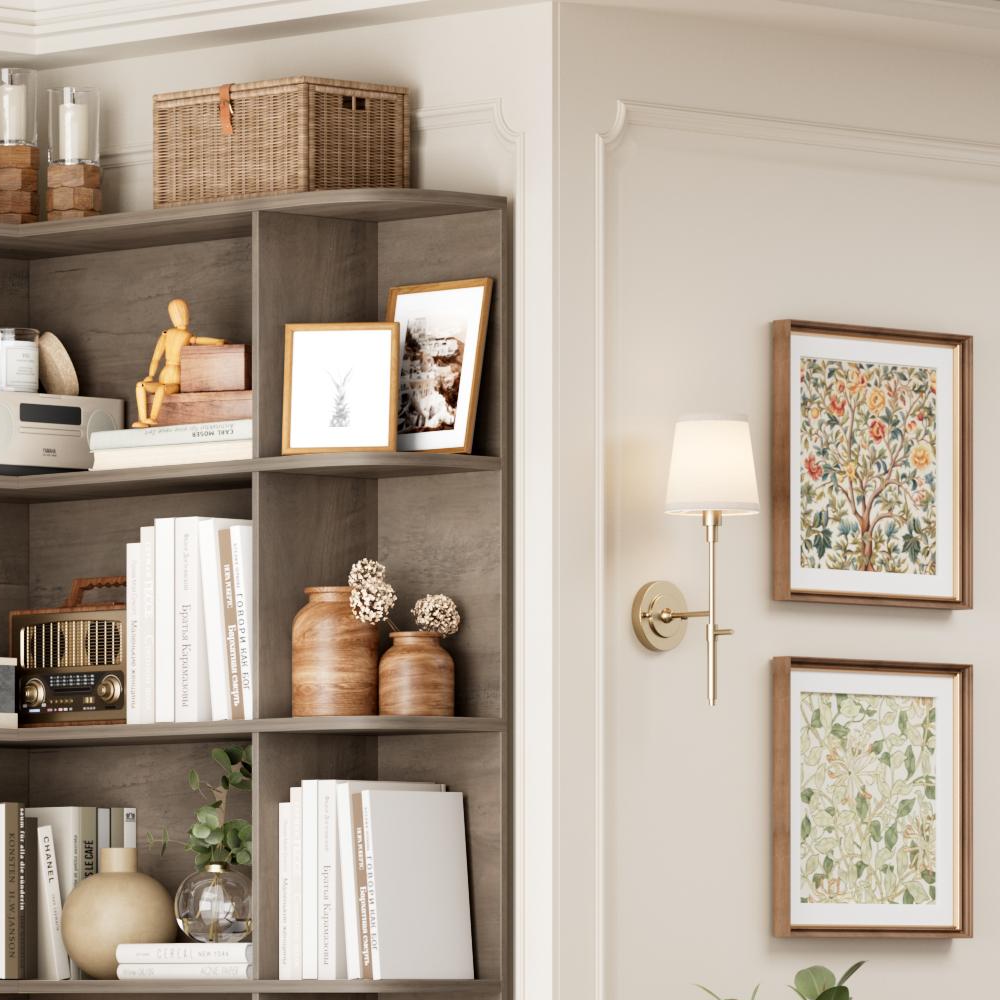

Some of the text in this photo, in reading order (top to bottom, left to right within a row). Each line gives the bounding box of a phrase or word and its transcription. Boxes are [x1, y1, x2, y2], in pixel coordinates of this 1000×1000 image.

[191, 428, 234, 438] CARL MOSER
[180, 604, 192, 641] Братья
[238, 593, 246, 644] ГОВОРИ
[180, 643, 192, 708] Карамазовы
[8, 833, 16, 883] KONSTEN
[43, 836, 54, 884] CHANEL
[84, 861, 94, 870] LE
